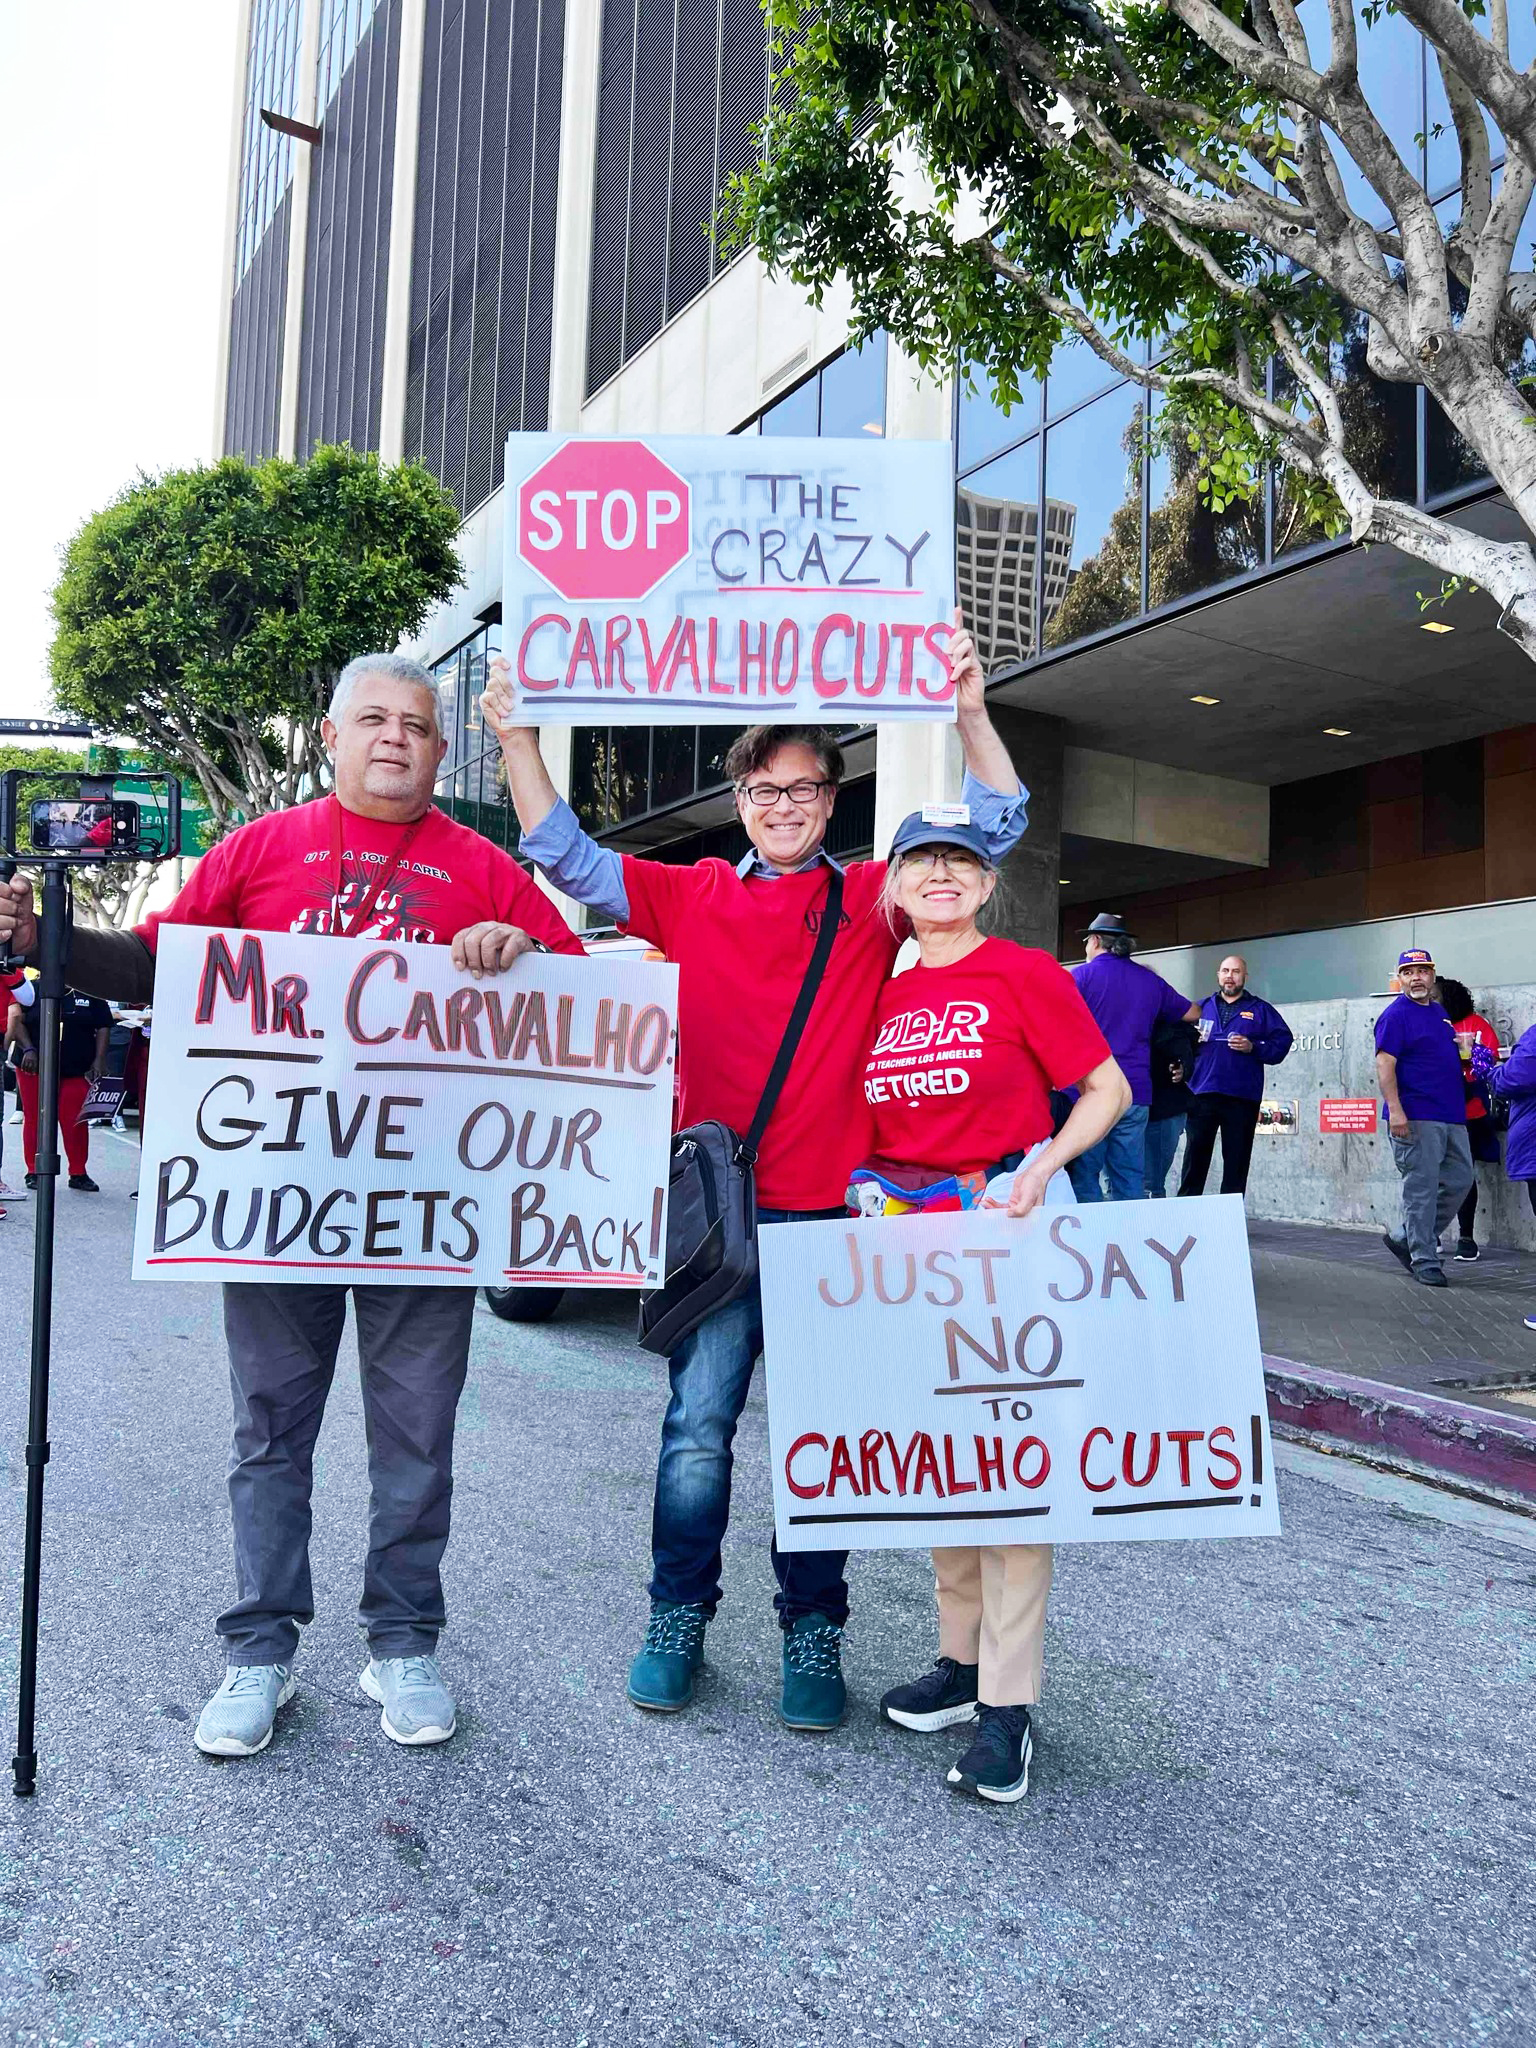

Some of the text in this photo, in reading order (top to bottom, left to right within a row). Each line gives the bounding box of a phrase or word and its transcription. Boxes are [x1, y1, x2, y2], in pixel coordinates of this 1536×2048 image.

[527, 489, 682, 551] STOP
[745, 474, 862, 522] THE
[710, 529, 931, 587] CRAZY
[517, 612, 959, 701] CARVALHO CUTS
[360, 852, 408, 870] SOUH
[412, 863, 452, 884] AREA
[195, 933, 678, 1076] MR. CARVALHO:
[877, 1056, 917, 1071] TEACHERS
[918, 1053, 935, 1065] LOS
[935, 1049, 983, 1061] ANGELES
[1290, 1032, 1341, 1051] strict
[97, 1091, 121, 1103] OUR
[864, 1067, 970, 1105] RETIRED
[196, 1075, 611, 1183] GIVE OUR
[154, 1156, 665, 1281] BUDGETS BACK!
[818, 1216, 1198, 1308] JUST SAY
[944, 1314, 1064, 1381] NO
[981, 1397, 1033, 1422] TO
[785, 1415, 1263, 1508] CARVALHO CUTS!
